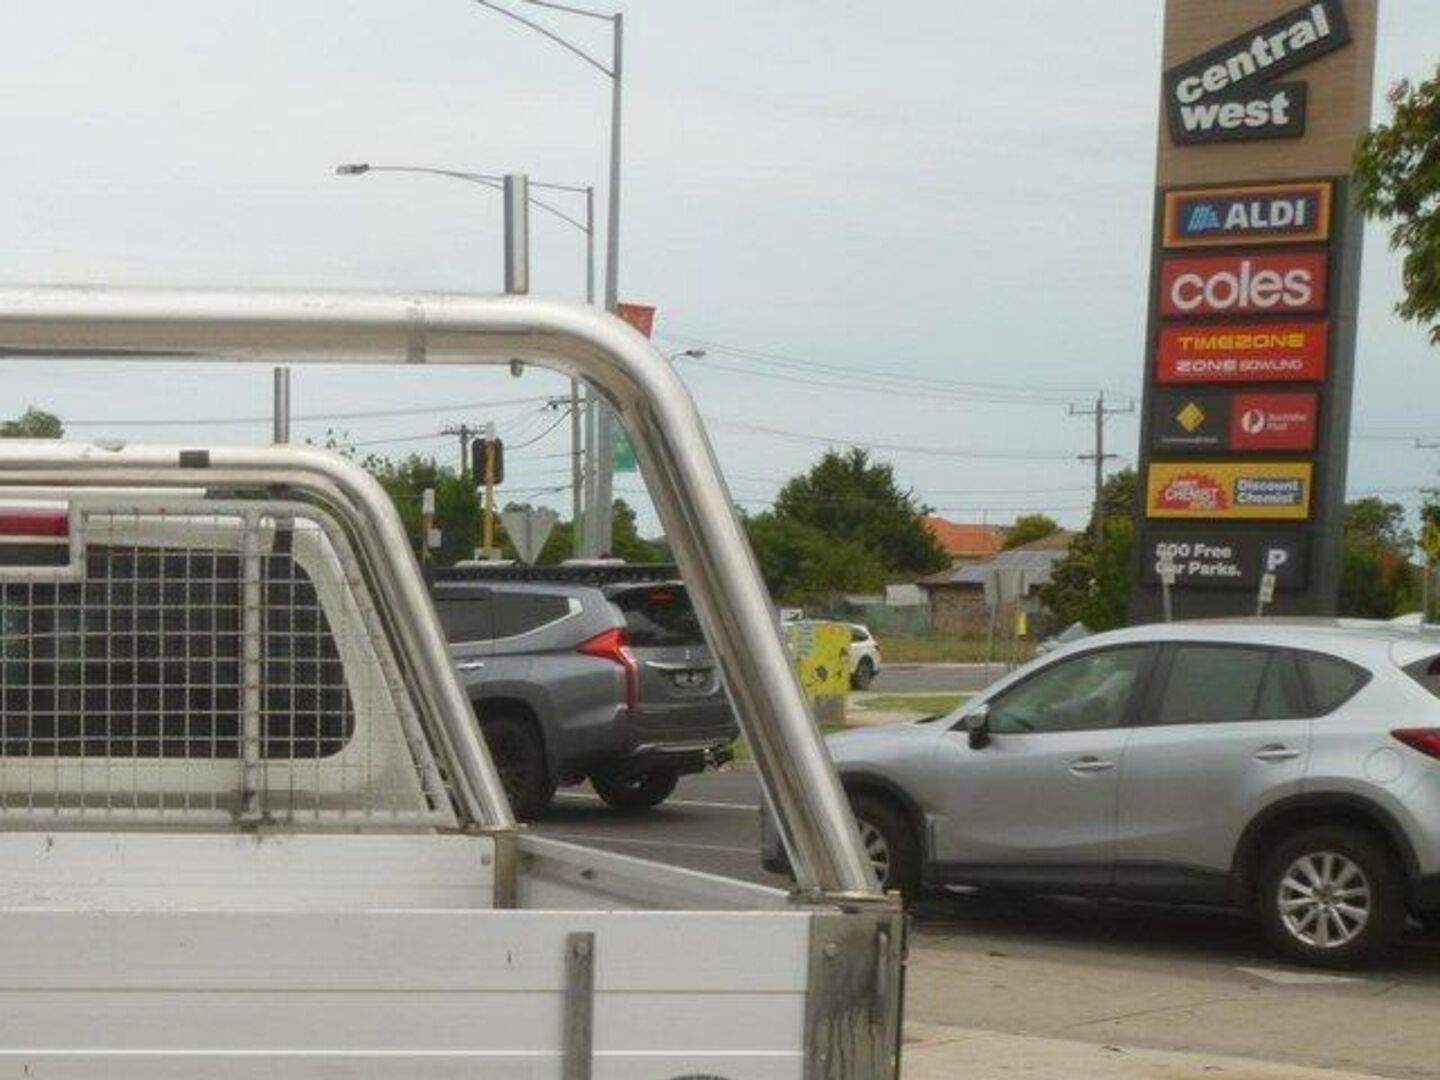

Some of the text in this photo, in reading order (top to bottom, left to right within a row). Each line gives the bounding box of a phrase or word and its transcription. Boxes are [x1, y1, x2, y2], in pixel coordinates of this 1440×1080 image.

[1176, 4, 1330, 103] central
[1181, 91, 1290, 131] west
[1224, 198, 1306, 229] ALDI
[1171, 260, 1311, 309] coles
[1177, 333, 1306, 350] TIMEZONE
[1176, 359, 1237, 372] ZONE
[1238, 478, 1299, 491] Discount
[1164, 487, 1219, 501] CHEMIST
[1237, 491, 1295, 504] Chemist
[1194, 544, 1232, 558] Free
[1267, 549, 1288, 571] P
[1155, 560, 1242, 577] Cr Parks.
